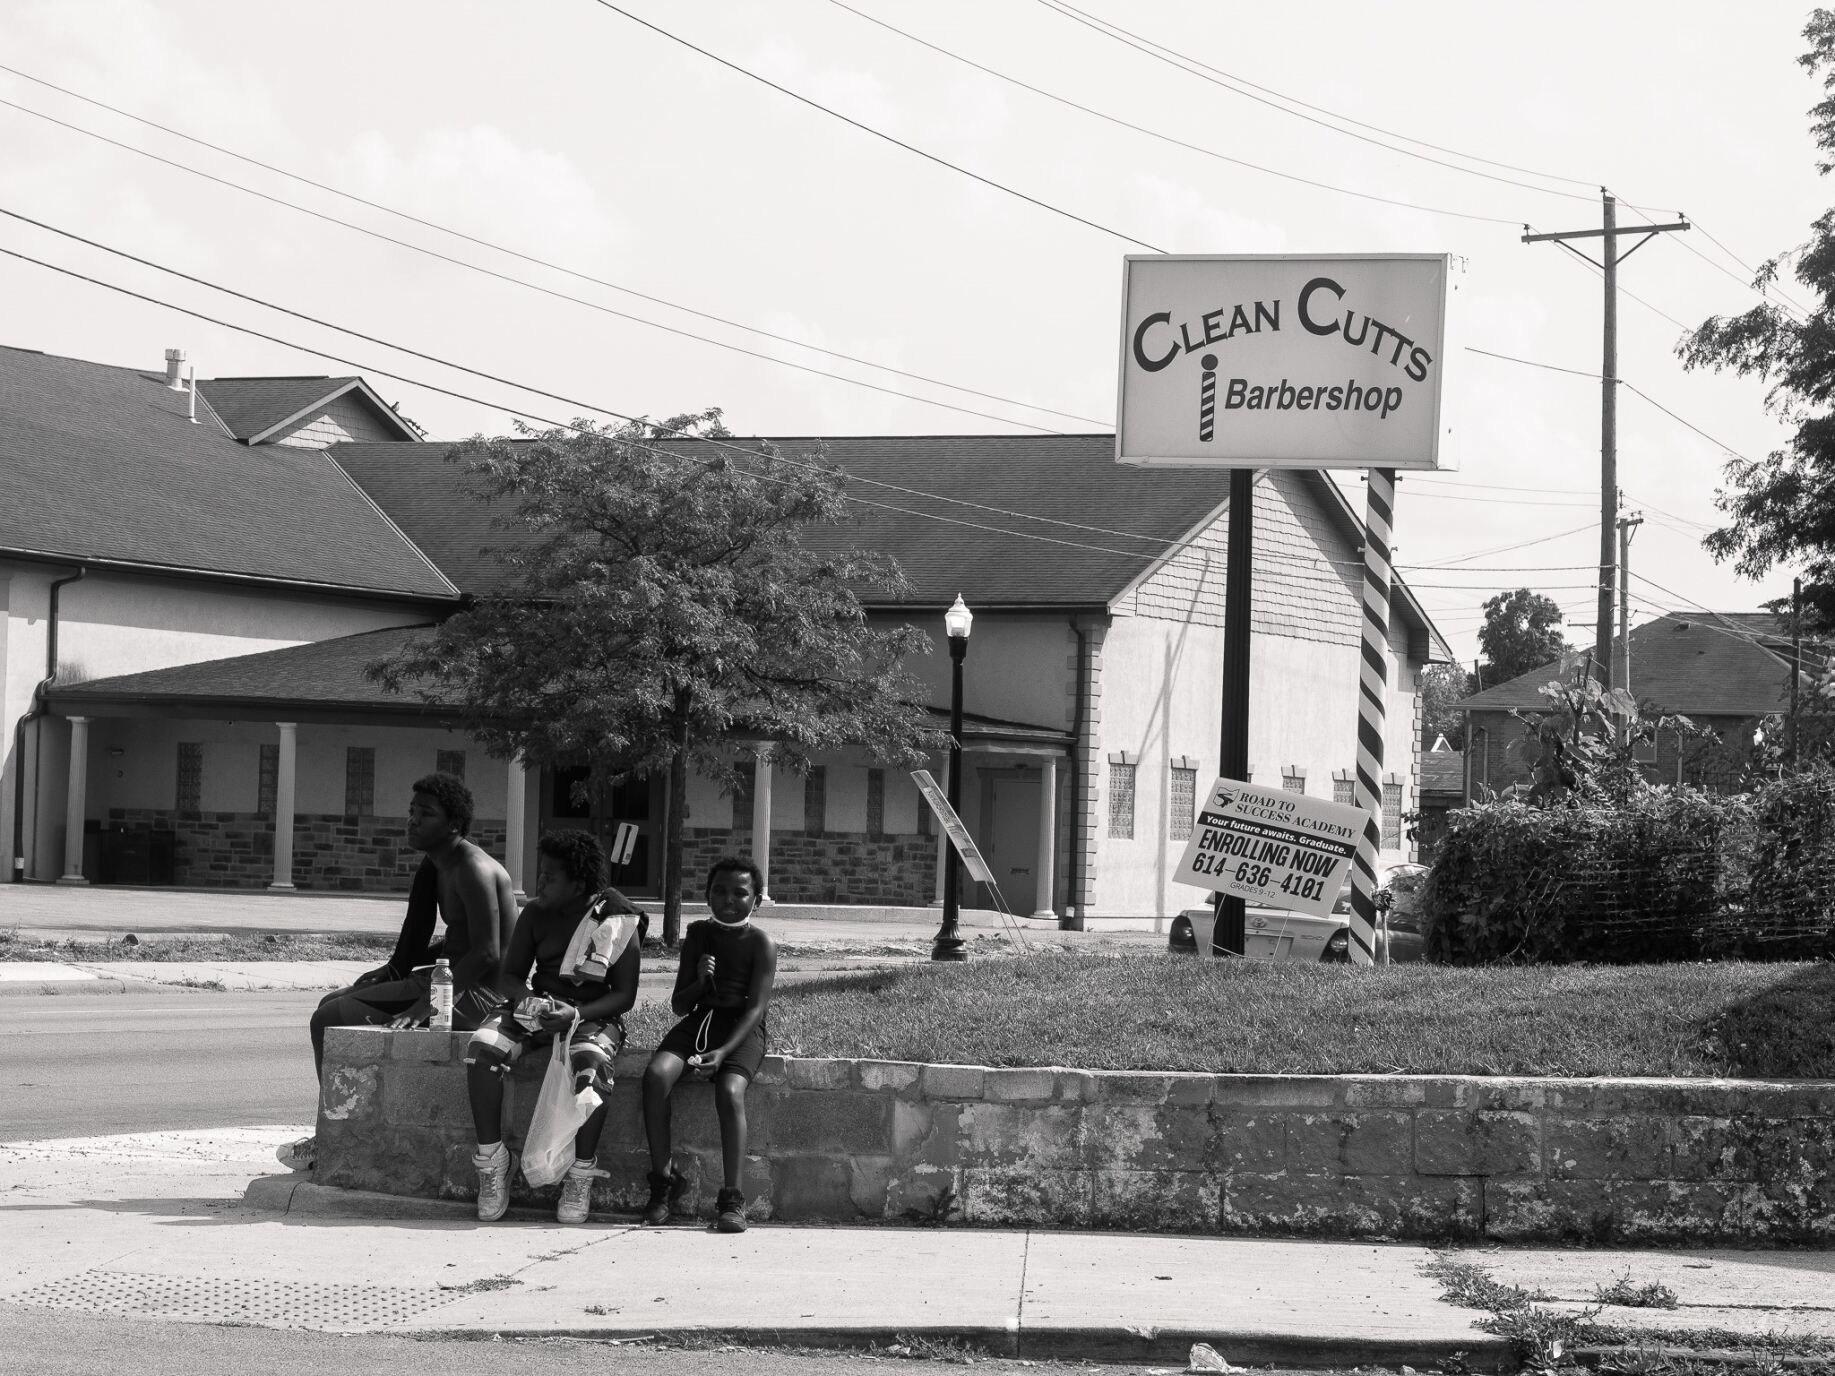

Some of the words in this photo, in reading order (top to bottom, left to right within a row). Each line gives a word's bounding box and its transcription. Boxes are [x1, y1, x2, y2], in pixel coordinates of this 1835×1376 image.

[1133, 300, 1280, 372] CLEAN
[1298, 277, 1433, 382] CUTTS
[1225, 379, 1403, 419] Barbershop
[1235, 804, 1291, 823] SUCCESS
[1292, 817, 1356, 839] ACADEMY
[1239, 792, 1276, 808] ROAD
[1279, 800, 1296, 812] TO
[1198, 829, 1290, 867] ENROLLING
[1289, 849, 1339, 878] NOW
[1206, 815, 1228, 827] Your
[1230, 820, 1261, 834] future
[1262, 826, 1297, 842] awaits.
[1299, 836, 1347, 855] Graduate.
[1192, 852, 1326, 901] 614-636-4101
[1230, 881, 1258, 894] GRADES
[1258, 888, 1276, 898] 9-12
